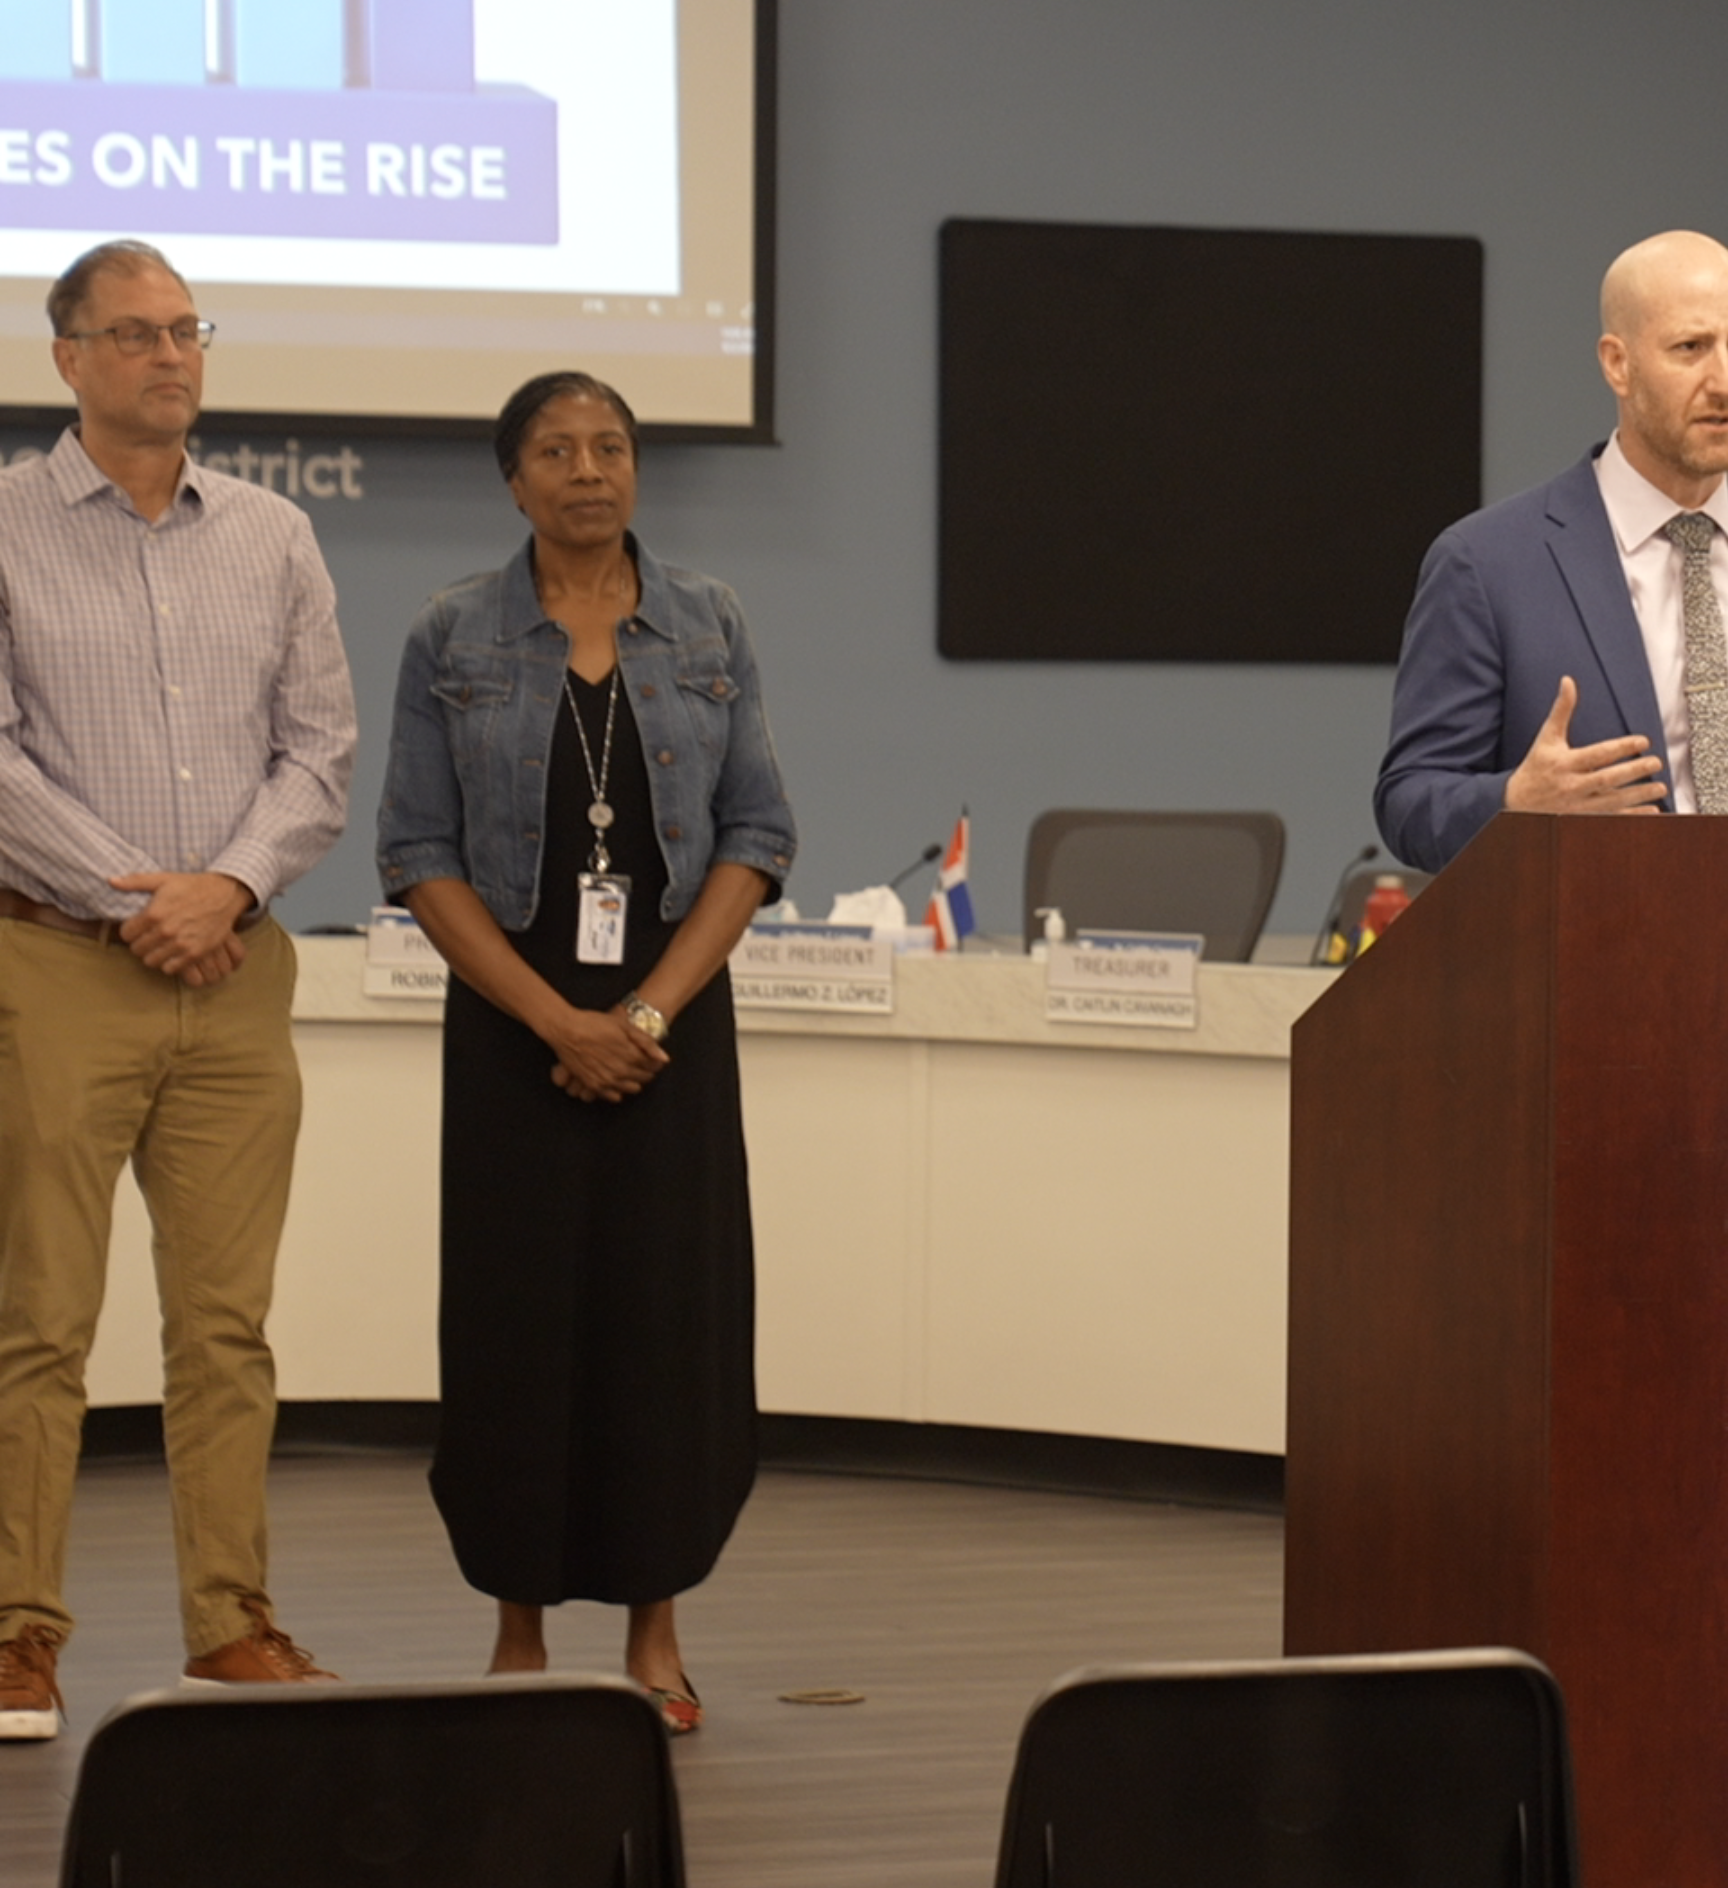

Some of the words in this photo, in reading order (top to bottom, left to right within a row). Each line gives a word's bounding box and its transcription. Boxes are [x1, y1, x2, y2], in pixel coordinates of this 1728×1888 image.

[91, 132, 199, 189] ON
[216, 137, 345, 194] THE
[366, 144, 507, 199] RISE
[189, 438, 363, 498] istrict
[745, 944, 778, 964] VICE
[788, 946, 875, 966] PRESIDENT
[1073, 955, 1170, 978] TREASURER
